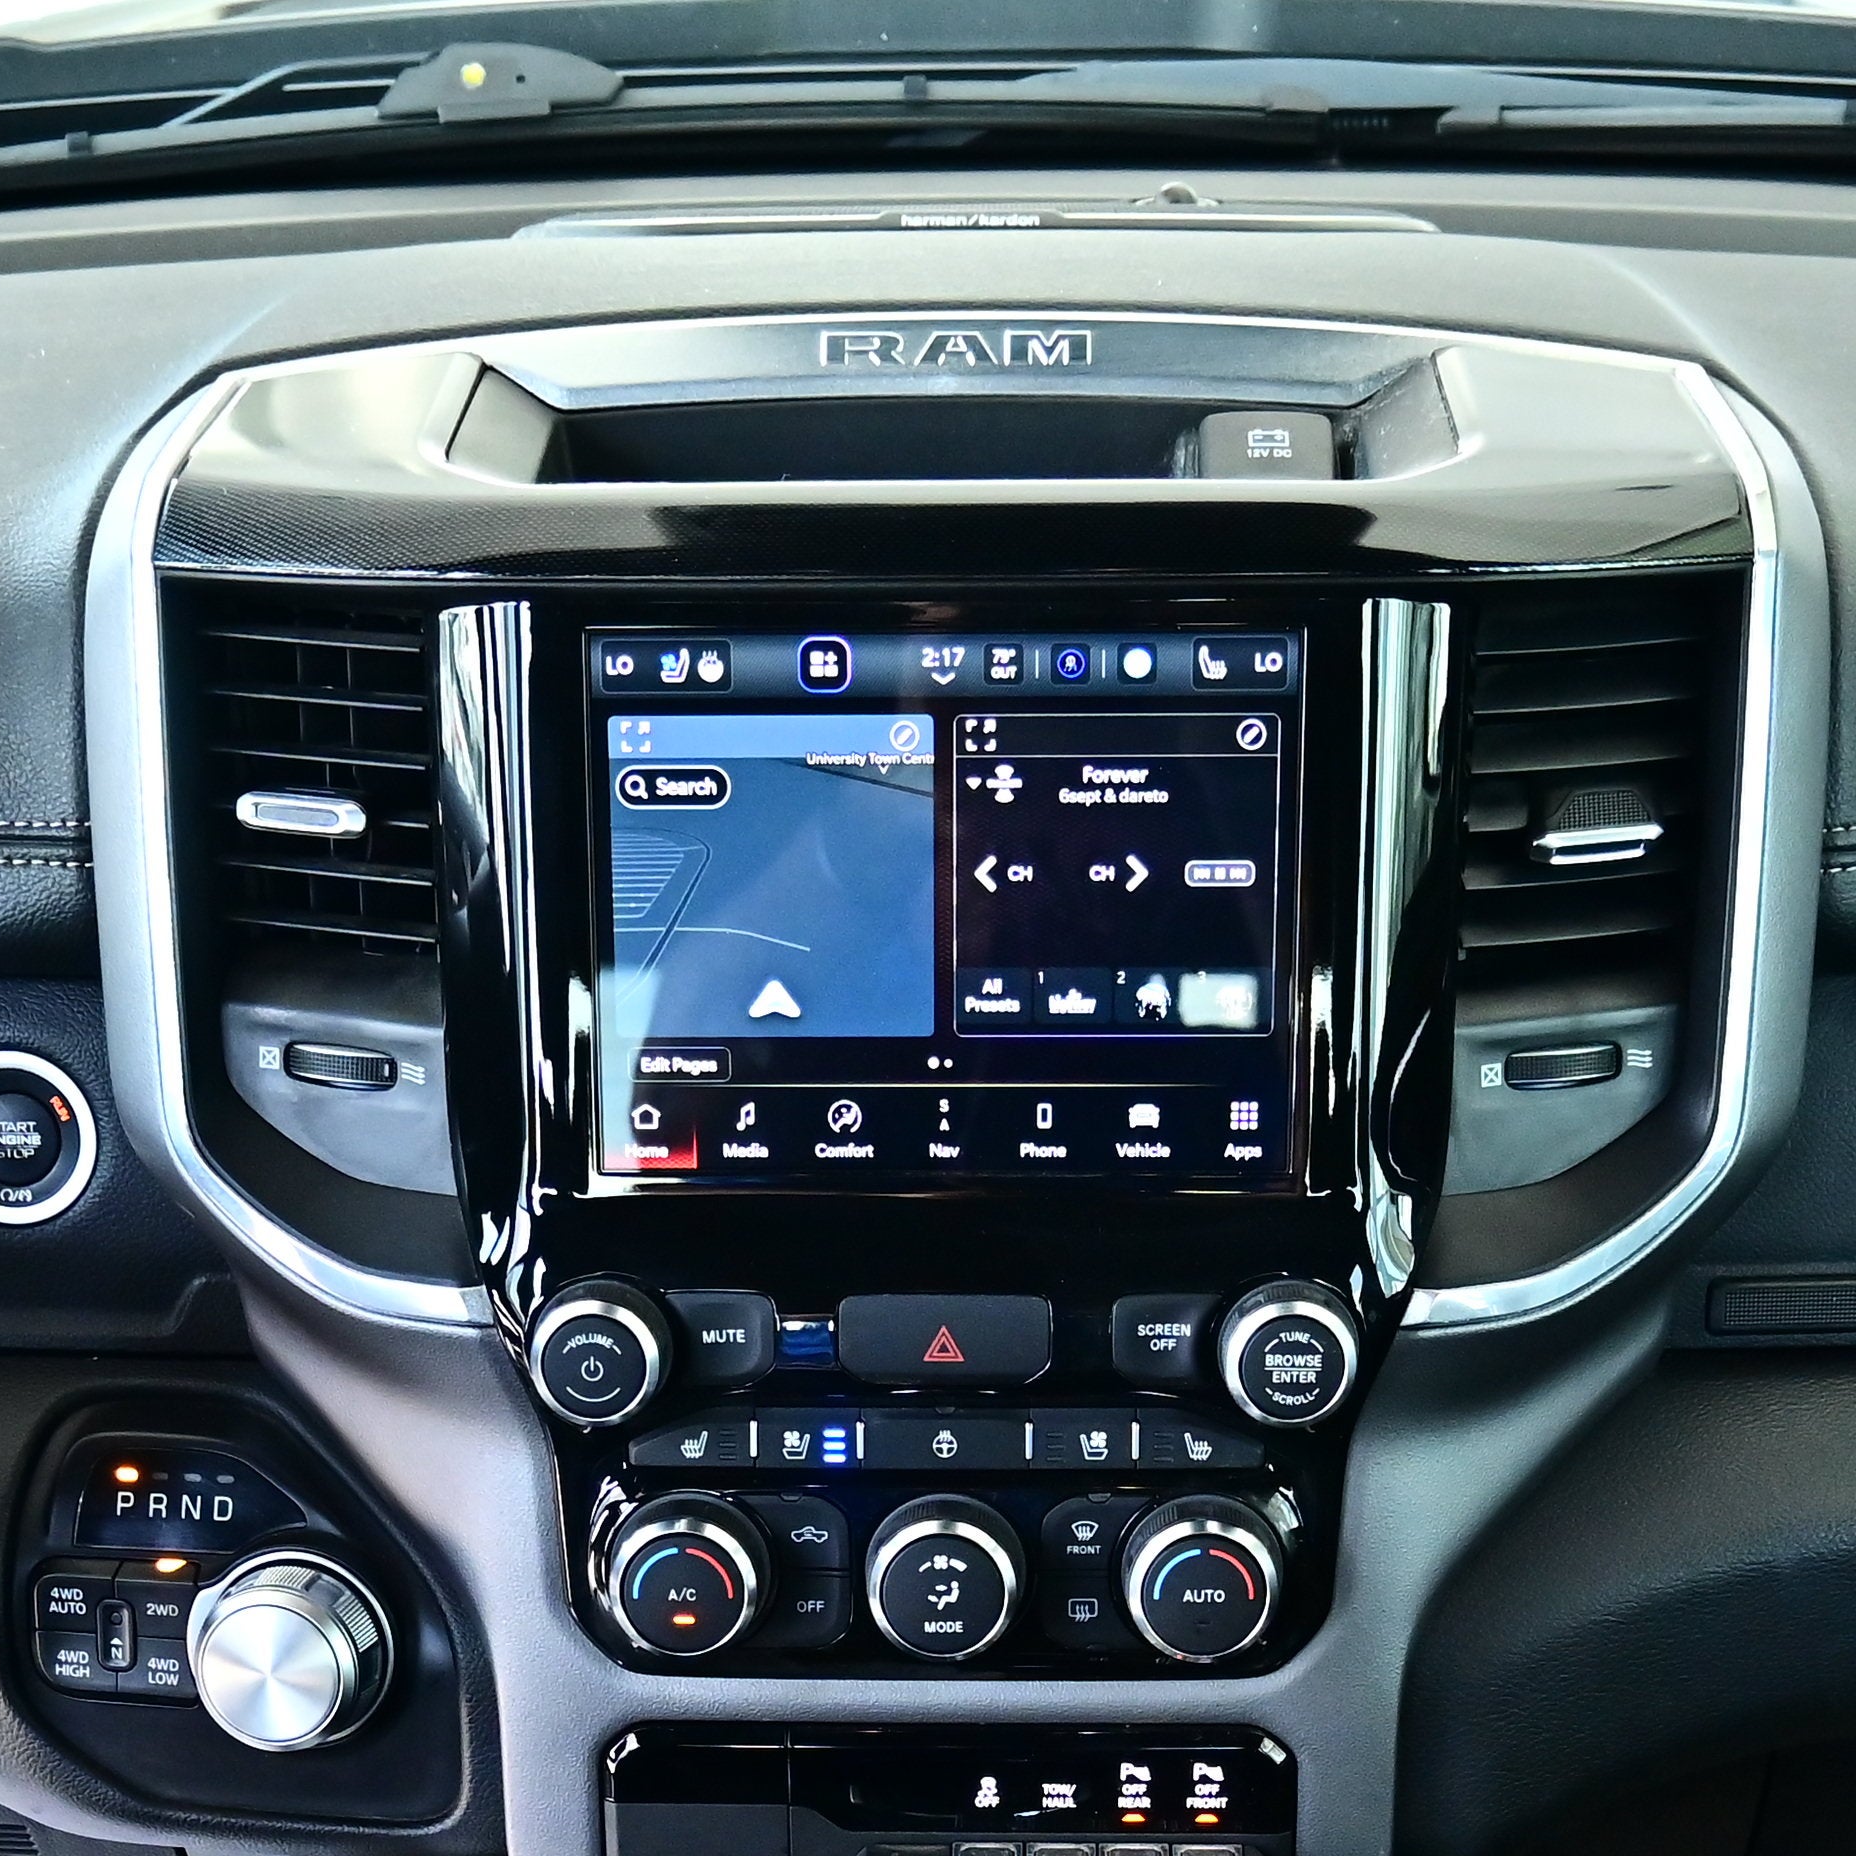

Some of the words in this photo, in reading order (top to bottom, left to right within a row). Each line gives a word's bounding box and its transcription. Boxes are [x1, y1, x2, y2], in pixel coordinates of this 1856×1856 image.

[901, 214, 1040, 227] harman/kardon
[819, 329, 1093, 368] RAM
[1246, 448, 1270, 458] 12V
[1273, 448, 1292, 458] DC
[921, 646, 966, 669] 2:17
[1254, 652, 1284, 673] LO
[605, 655, 634, 676] LO
[990, 665, 1018, 680] OUT
[806, 752, 866, 767] University
[868, 752, 901, 765] Town
[1082, 765, 1149, 784] Forever
[655, 776, 717, 797] Search
[1058, 788, 1102, 807] 6sept
[1103, 788, 1117, 803] &
[1119, 787, 1169, 803] dareto
[1007, 865, 1034, 882] CH
[1088, 865, 1115, 882] CH
[982, 978, 1003, 995] All
[965, 996, 1021, 1014] Presets
[640, 1057, 672, 1073] Edit
[673, 1057, 718, 1077] Pages
[624, 1143, 669, 1159] Home
[723, 1143, 769, 1159] Media
[815, 1143, 874, 1159] Comfort
[929, 1143, 960, 1159] Nav
[1019, 1143, 1067, 1159] Phone
[1115, 1143, 1171, 1159] Vehicle
[1224, 1143, 1263, 1162] Apps
[702, 1329, 746, 1344] MUTE
[1137, 1323, 1191, 1337] SCREEN
[567, 1333, 615, 1350] VOLUME
[1150, 1338, 1177, 1352] OFF
[1279, 1331, 1311, 1345] TUNE
[1264, 1353, 1323, 1368] BROWSE
[1271, 1370, 1317, 1384] ENTER
[1271, 1390, 1316, 1406] SCROLL
[116, 1491, 135, 1517] P
[148, 1492, 168, 1518] R
[180, 1494, 202, 1520] N
[213, 1495, 234, 1522] D
[1066, 1544, 1101, 1556] FRONT
[50, 1587, 84, 1602] 4WD
[667, 1586, 697, 1603] A/C
[1182, 1589, 1226, 1604] AUTO
[49, 1601, 87, 1615] AUTO
[146, 1603, 179, 1617] 2WD
[796, 1601, 825, 1613] OFF
[924, 1621, 964, 1634] MODE
[57, 1649, 90, 1664] 4WD
[110, 1646, 123, 1660] N
[55, 1663, 90, 1679] HIGH
[147, 1657, 179, 1672] 4WD
[148, 1671, 179, 1687] LOW
[1042, 1783, 1077, 1797] TOW/
[1121, 1784, 1147, 1796] OFF
[1194, 1784, 1220, 1796] OFF
[974, 1796, 1000, 1808] OFF
[1042, 1796, 1077, 1809] HAUL
[1118, 1796, 1151, 1809] REAR
[1186, 1796, 1229, 1809] FRONT
